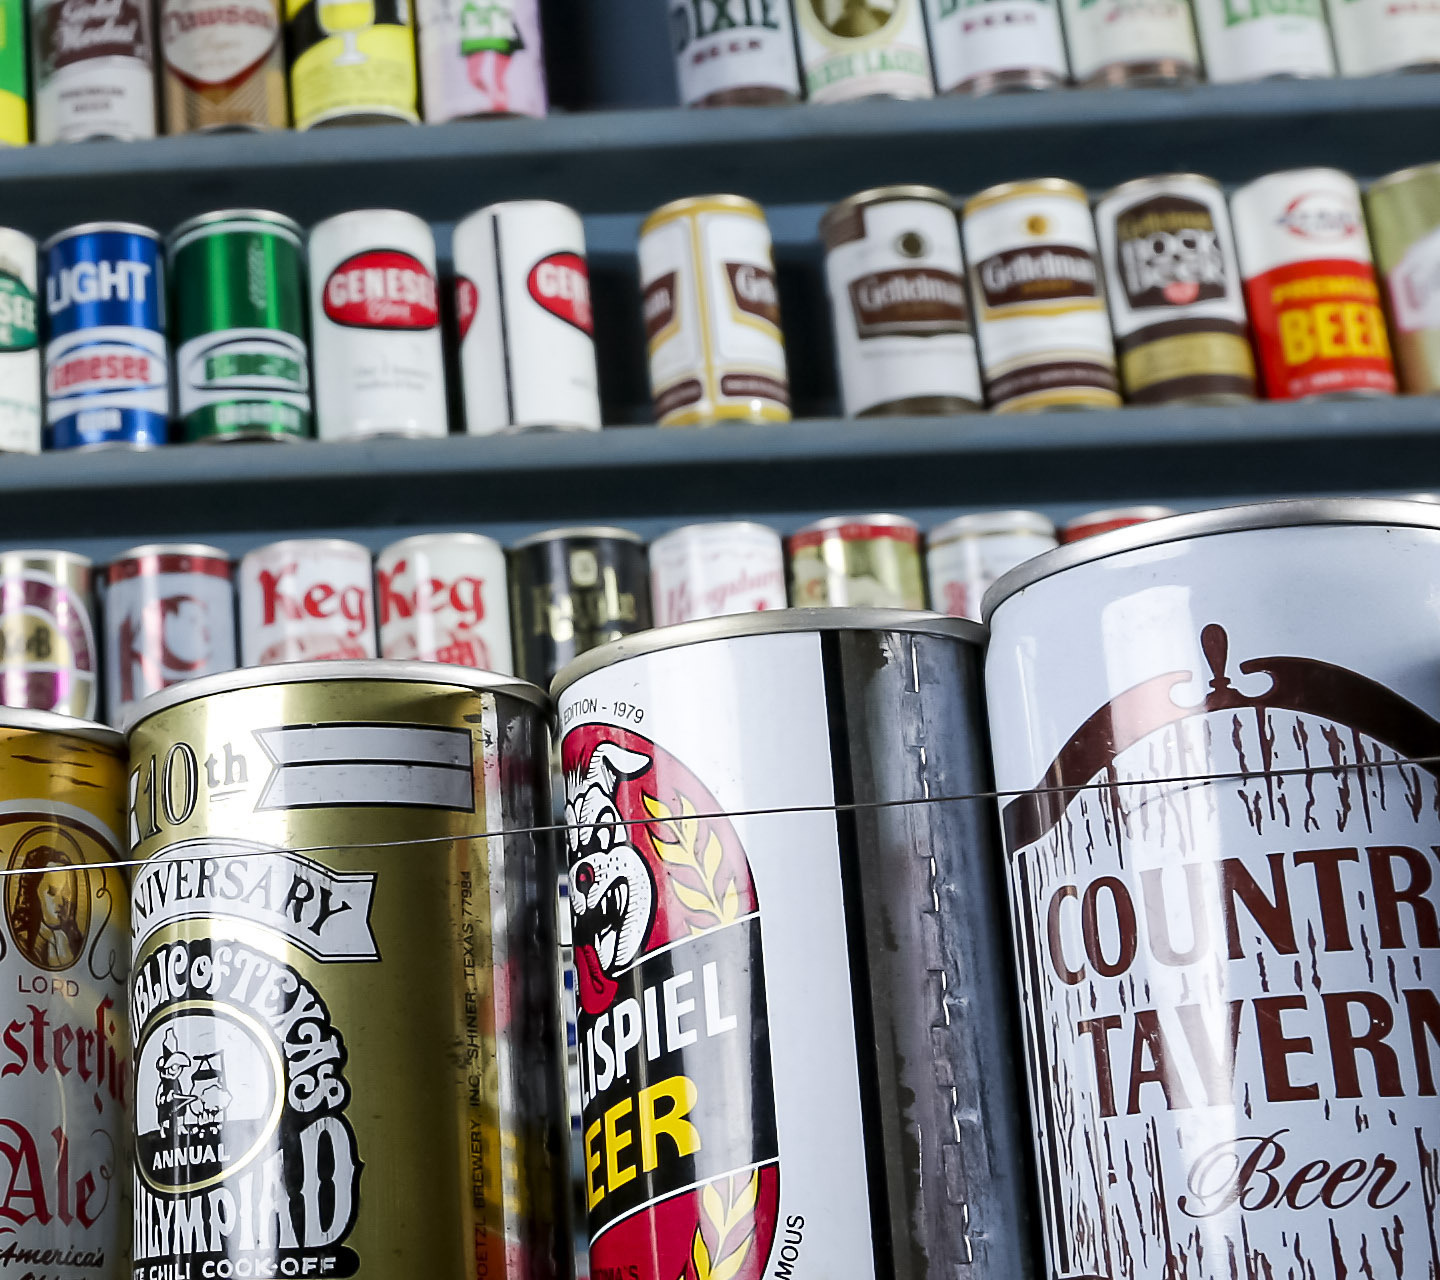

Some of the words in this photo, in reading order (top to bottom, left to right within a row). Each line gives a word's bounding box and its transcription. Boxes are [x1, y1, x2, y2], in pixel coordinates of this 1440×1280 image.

[47, 261, 152, 313] LIGHT
[258, 566, 368, 638] Keg
[378, 558, 486, 622] Keg
[612, 700, 644, 724] 1979
[459, 869, 474, 918] 77984
[461, 922, 476, 980] TEXAS
[18, 974, 80, 997] LORD
[132, 945, 188, 1048] UBLIC
[189, 946, 234, 996] of
[233, 950, 345, 1113] TEXAS
[152, 1143, 231, 1171] ANNUAL
[583, 1072, 701, 1214] EER
[134, 1116, 355, 1261] HILYMPIAD
[1178, 1127, 1411, 1219] Beer
[202, 1256, 337, 1278] COOK-OFF
